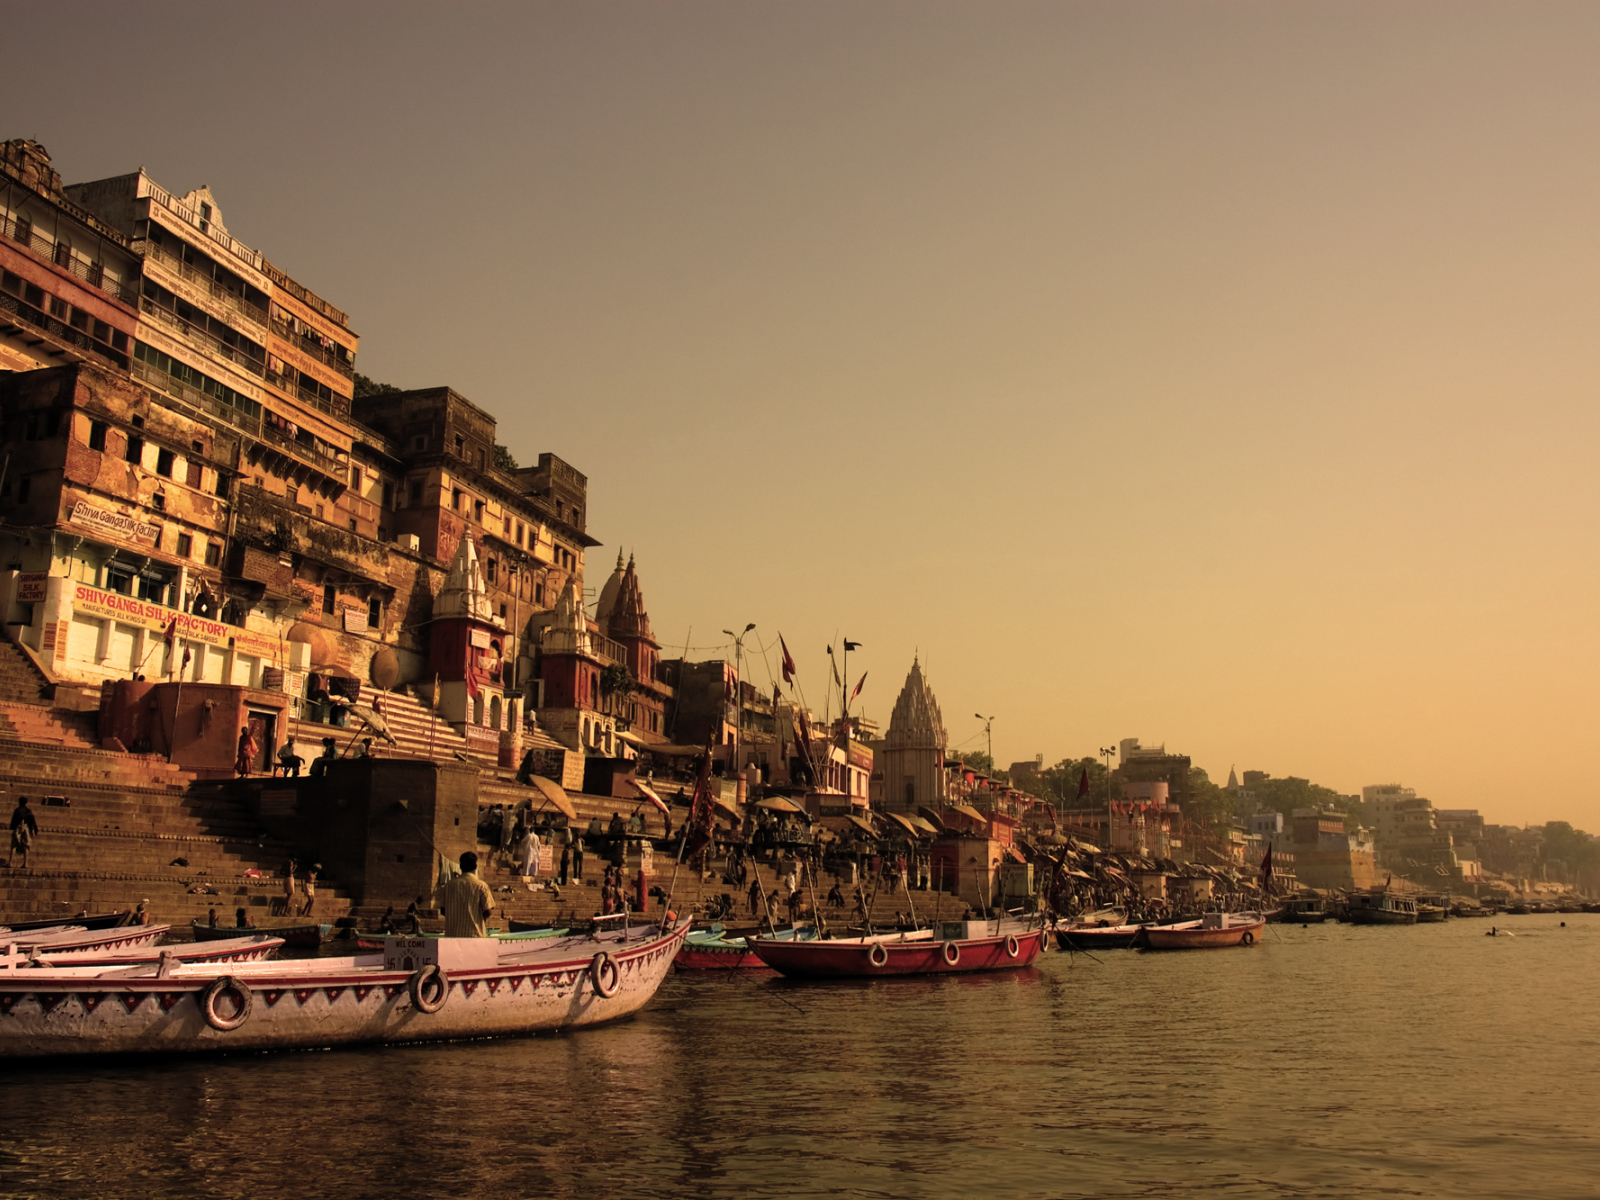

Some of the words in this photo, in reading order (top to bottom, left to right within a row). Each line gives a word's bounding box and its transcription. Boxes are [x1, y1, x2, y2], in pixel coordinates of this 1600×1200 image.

[19, 591, 45, 599] FACTORY
[145, 605, 176, 624] SILK
[177, 612, 229, 638] FACTORY
